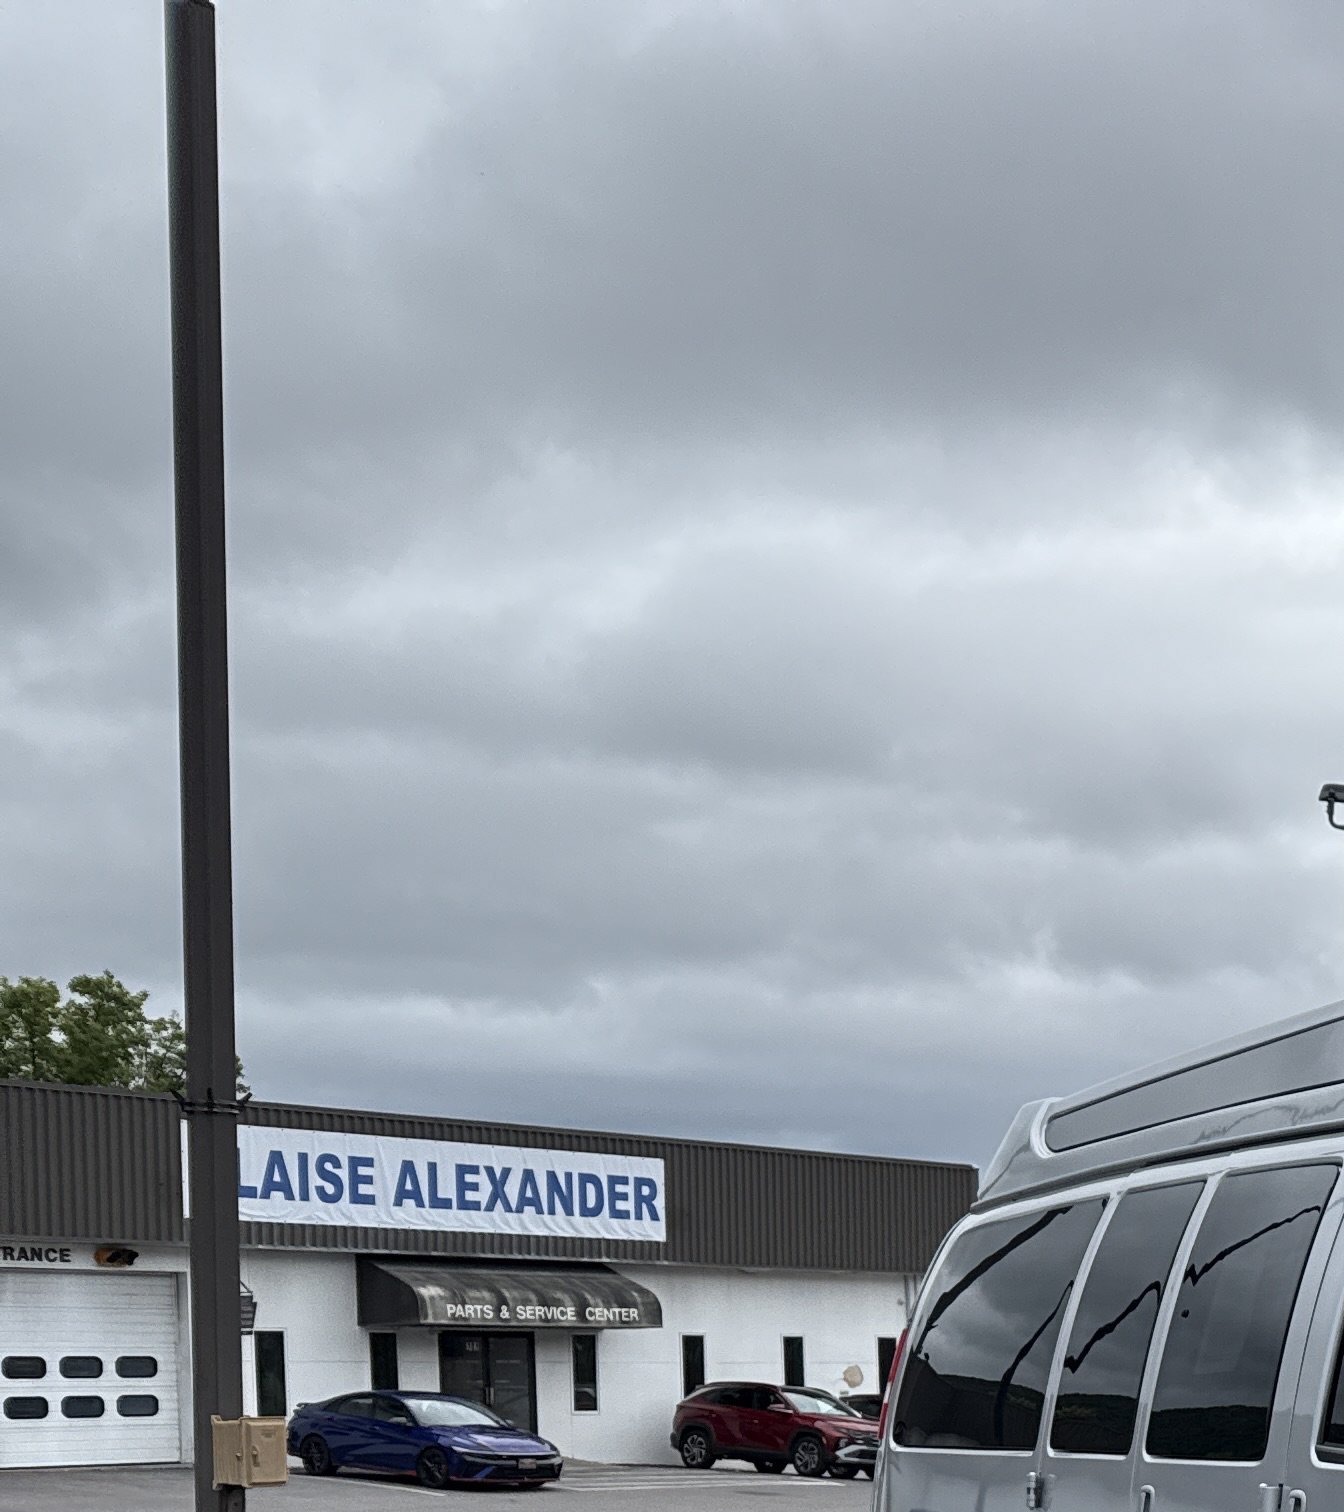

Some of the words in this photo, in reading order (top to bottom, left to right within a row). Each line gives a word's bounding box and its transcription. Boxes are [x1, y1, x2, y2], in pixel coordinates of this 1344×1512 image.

[237, 1147, 376, 1206] LAISE
[392, 1158, 661, 1222] ALEXANDER
[0, 1246, 72, 1263] RANCE
[446, 1303, 494, 1319] PARTS
[500, 1305, 510, 1319] &
[516, 1305, 576, 1321] SERVICE
[585, 1306, 639, 1322] CENTER
